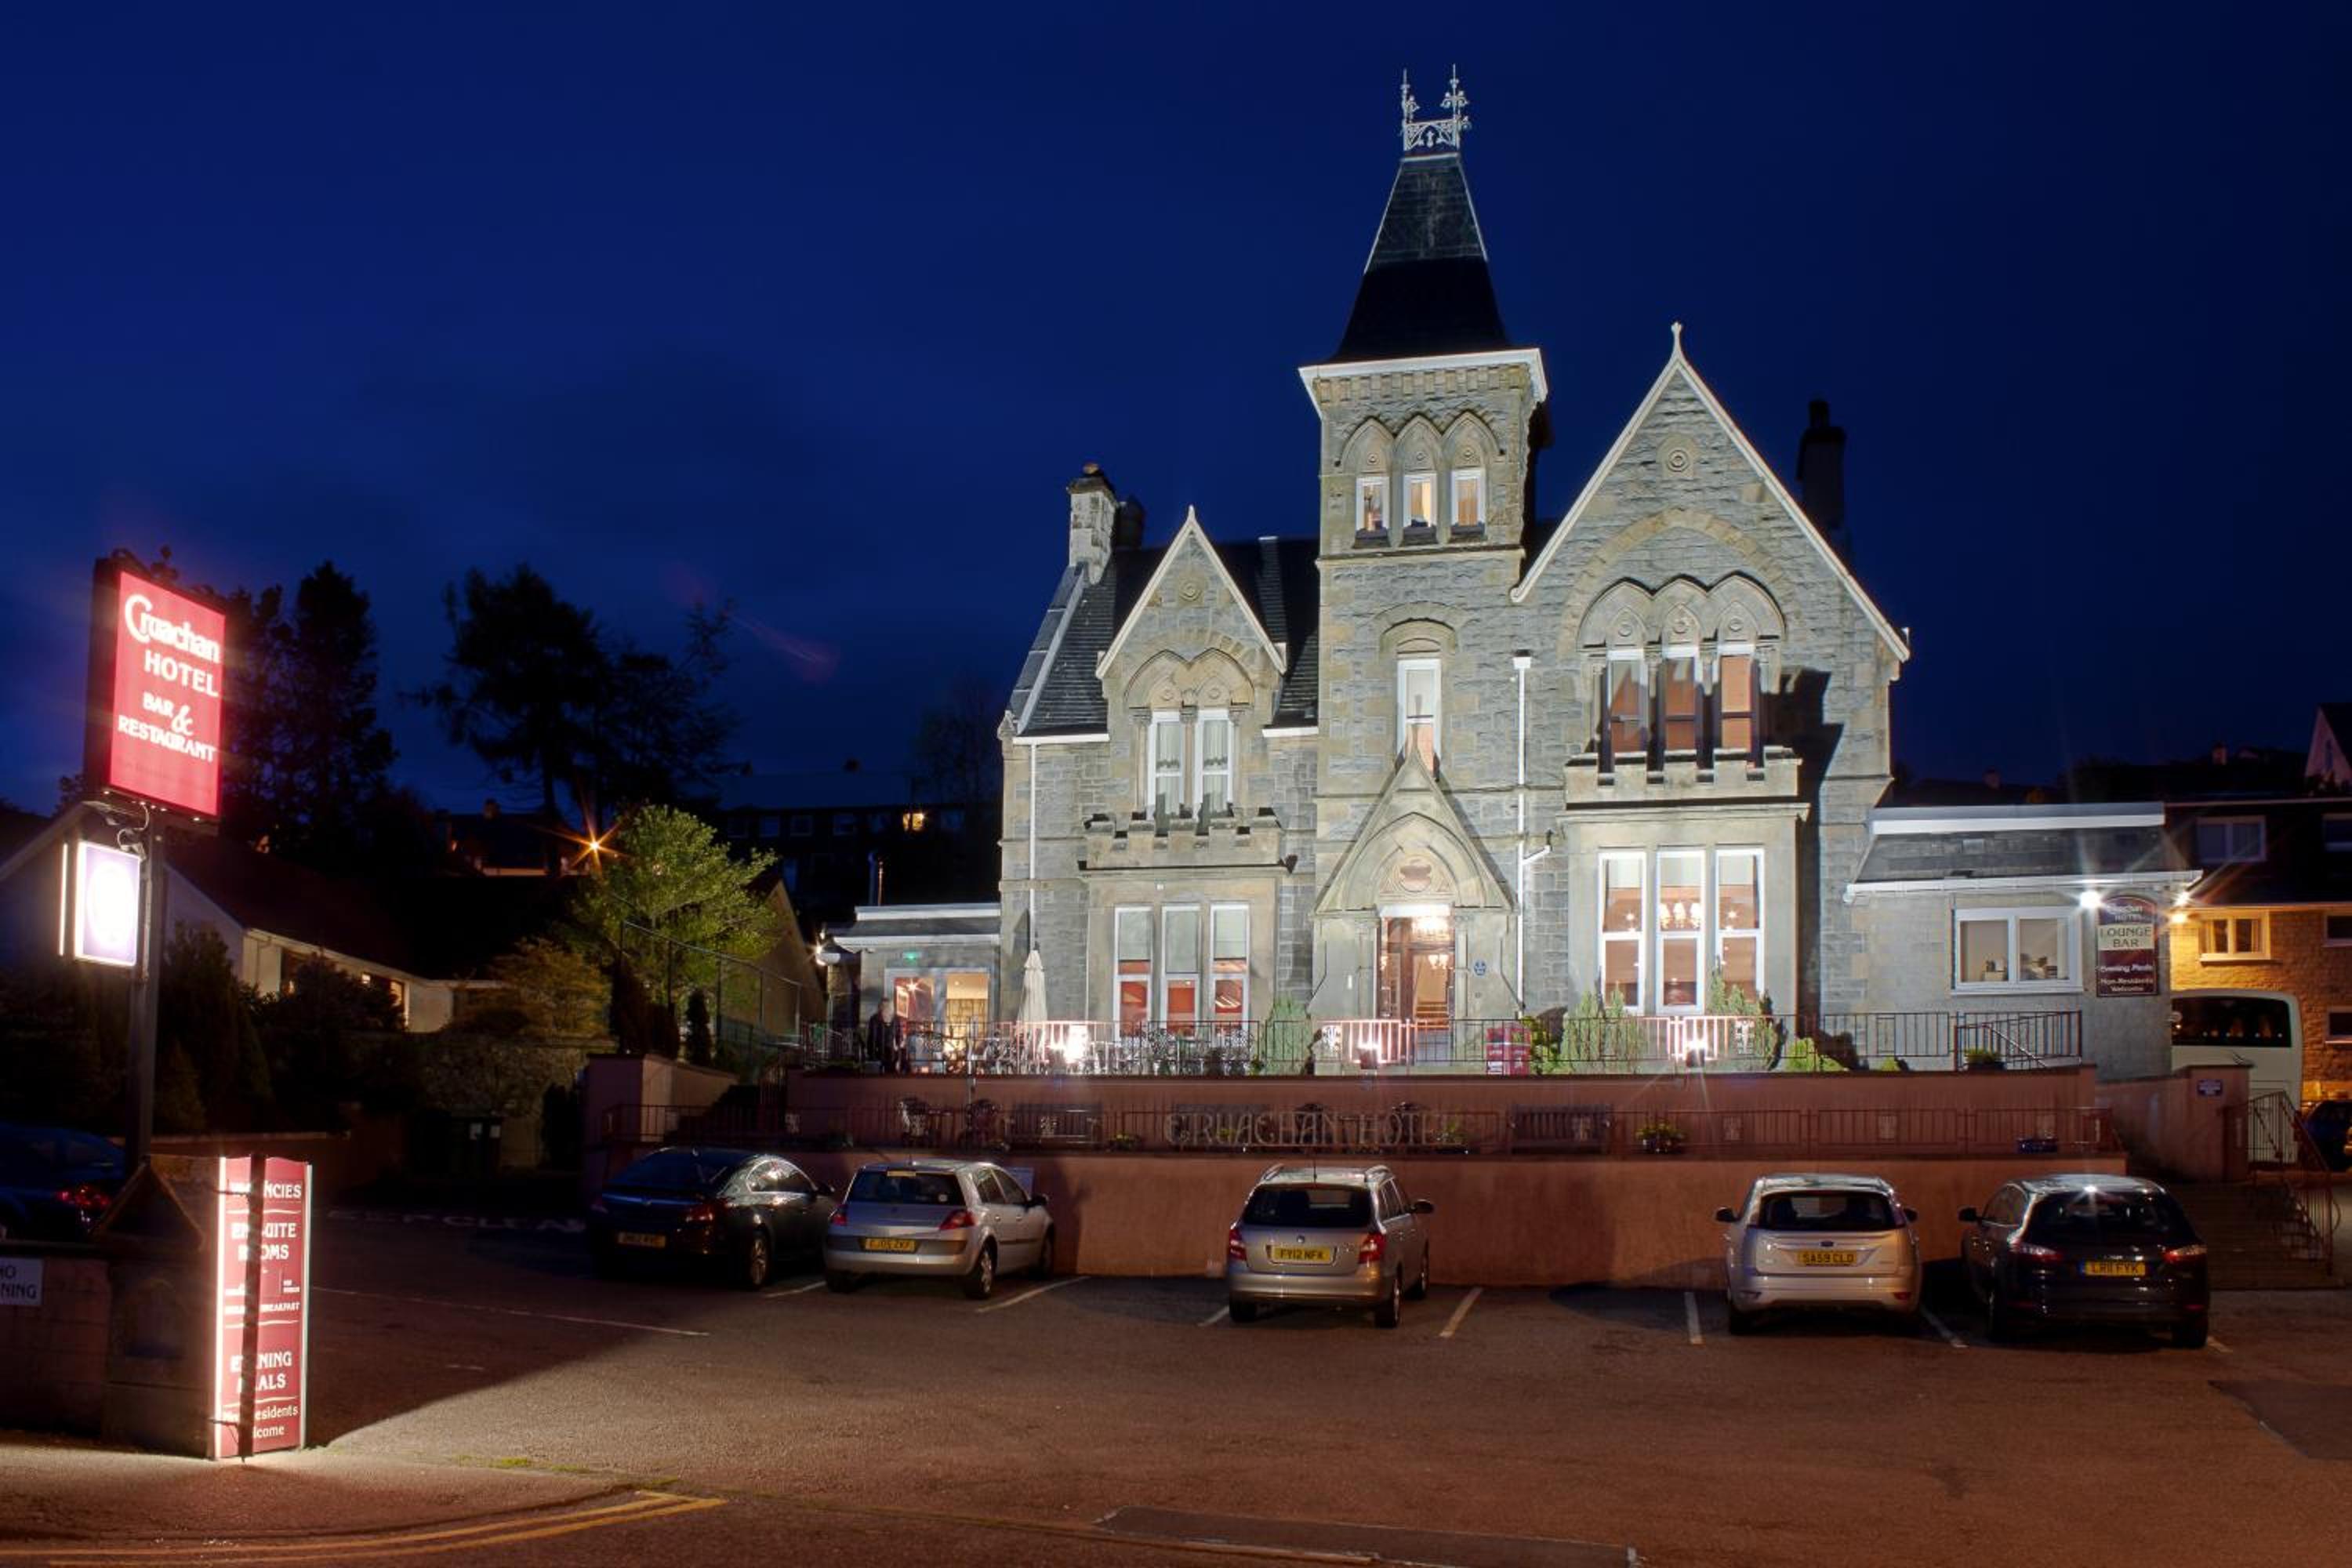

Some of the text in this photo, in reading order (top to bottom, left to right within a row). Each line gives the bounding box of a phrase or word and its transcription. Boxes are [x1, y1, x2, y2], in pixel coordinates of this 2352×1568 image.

[125, 593, 221, 664] Cruachan
[143, 648, 219, 698] HOTEL
[143, 691, 173, 719] BAR
[118, 714, 216, 763] RESTAURANT
[2100, 927, 2153, 938] LOUNGE
[2113, 938, 2139, 947] BAR
